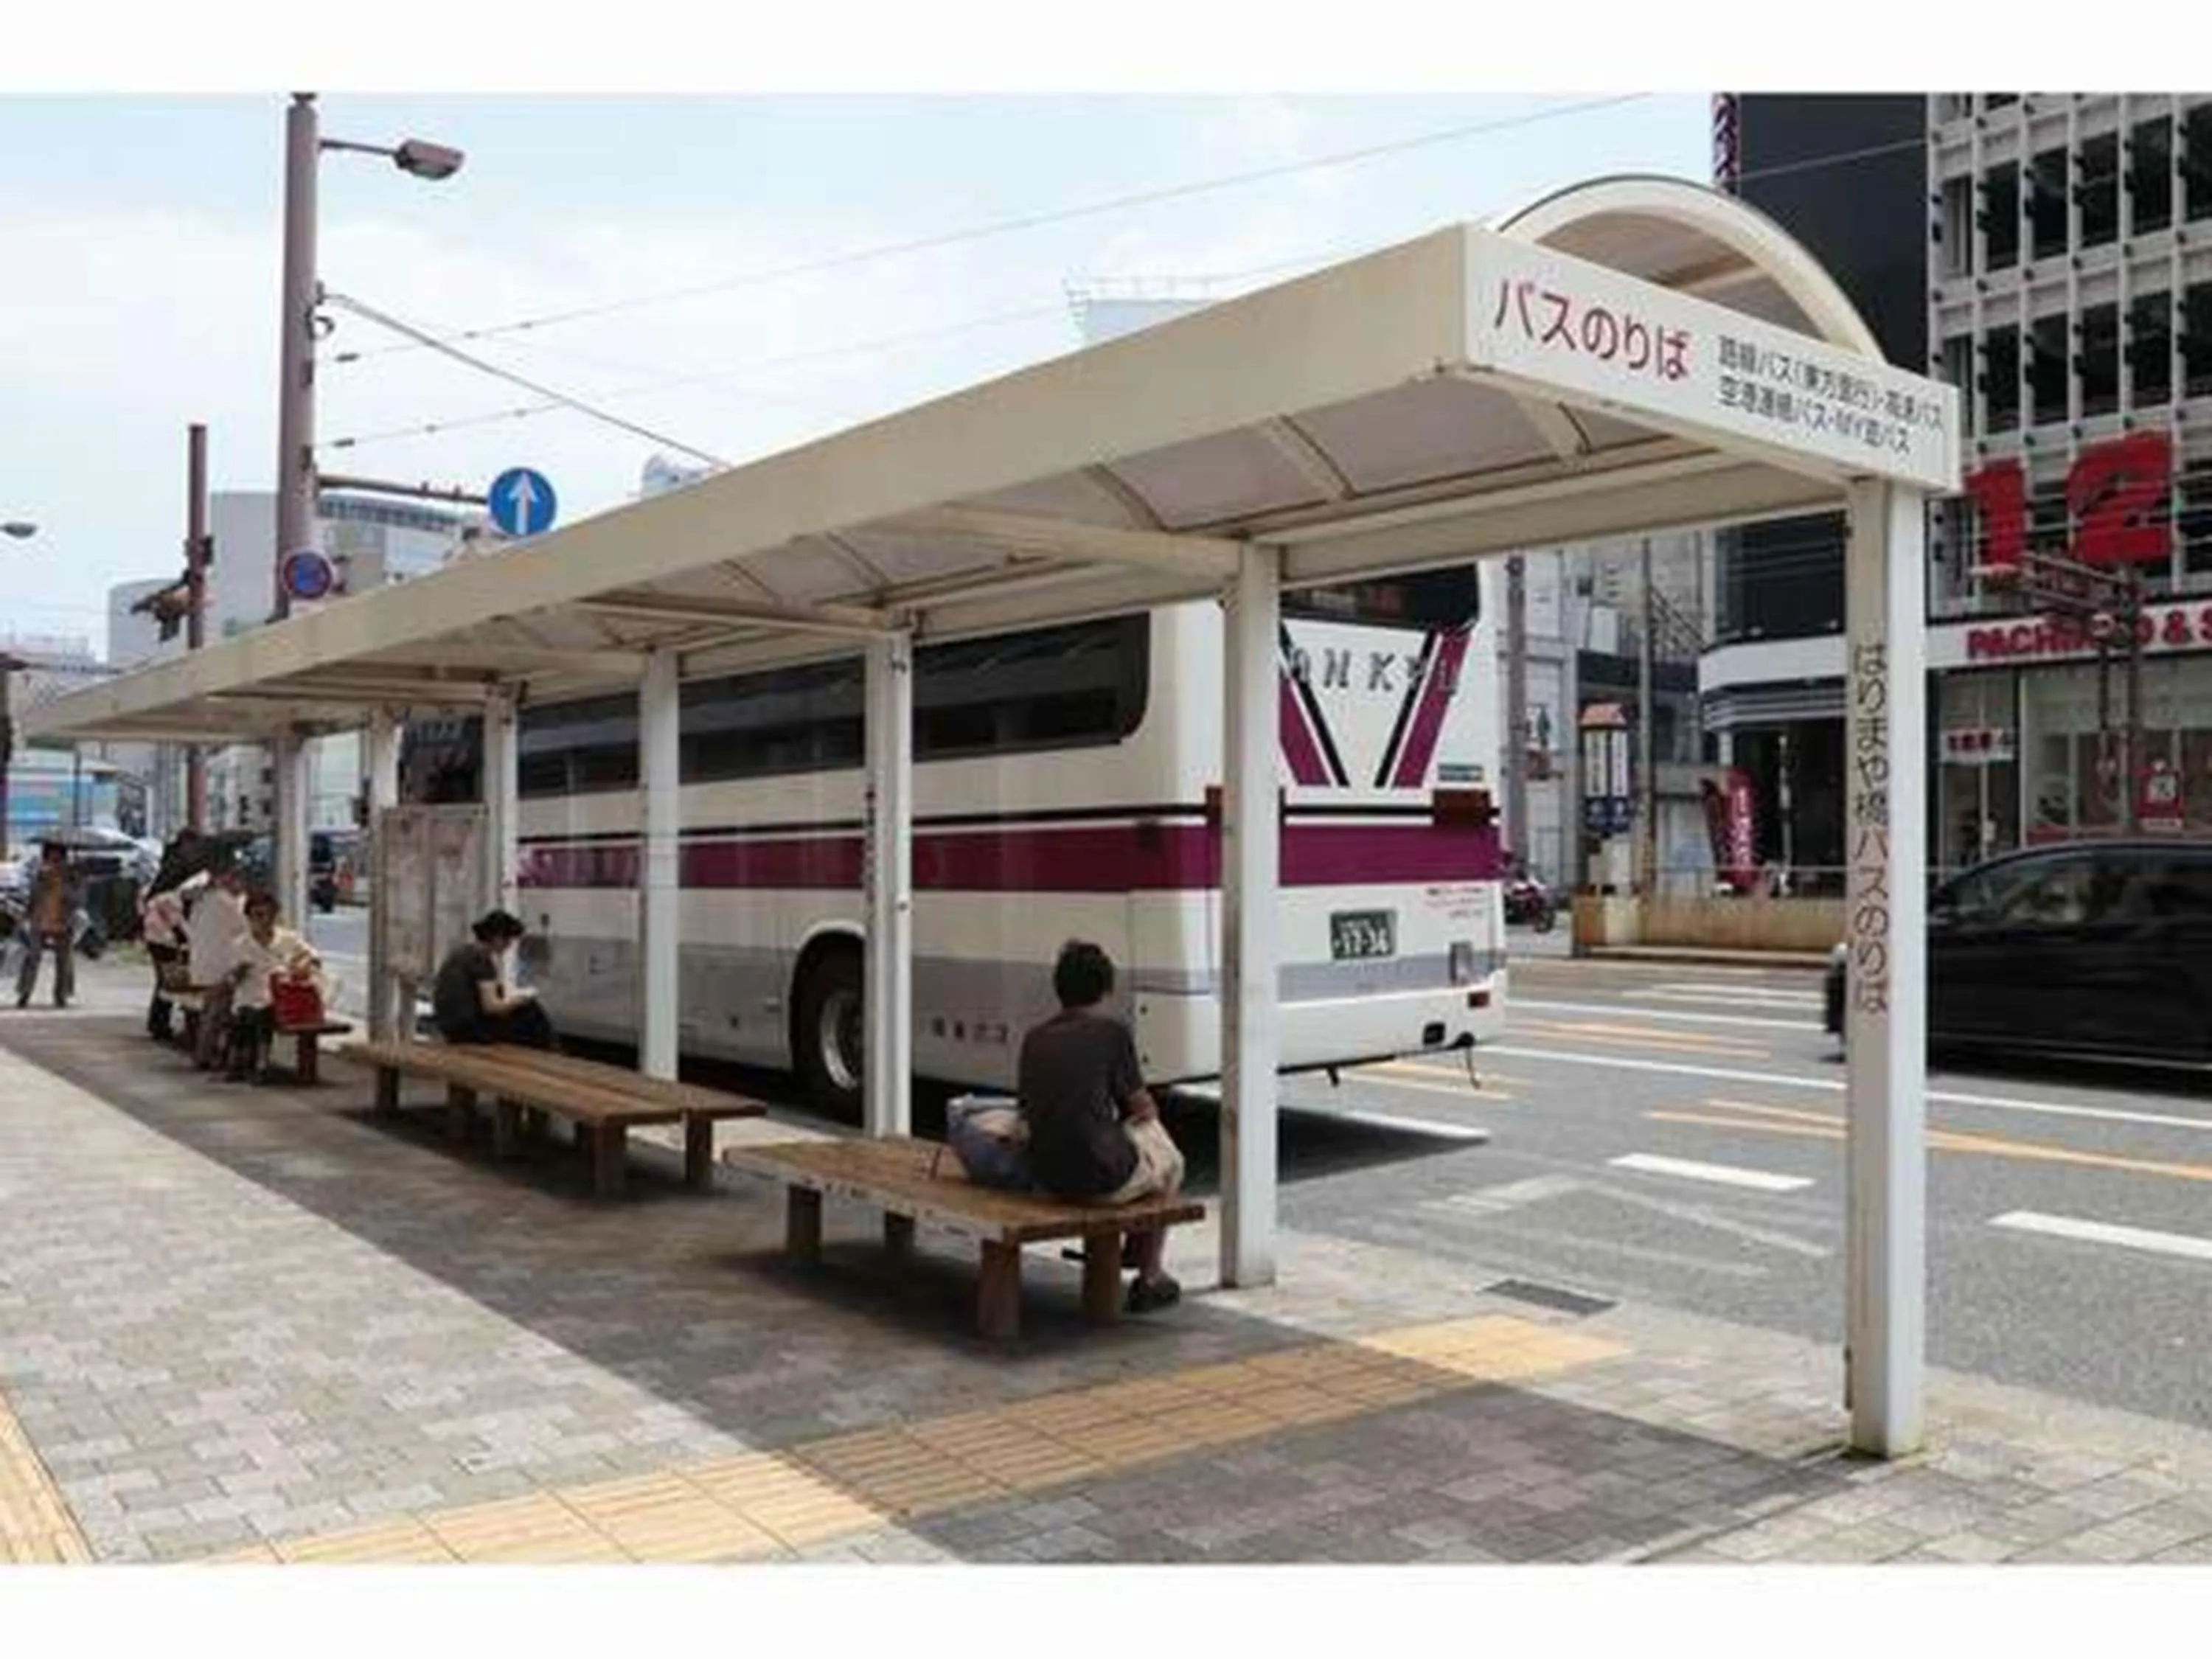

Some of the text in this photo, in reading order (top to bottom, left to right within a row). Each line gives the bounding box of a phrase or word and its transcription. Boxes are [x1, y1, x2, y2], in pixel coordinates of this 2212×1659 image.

[1495, 278, 1690, 381] バスのりば
[1964, 425, 2174, 566] 12
[2162, 610, 2193, 644] &
